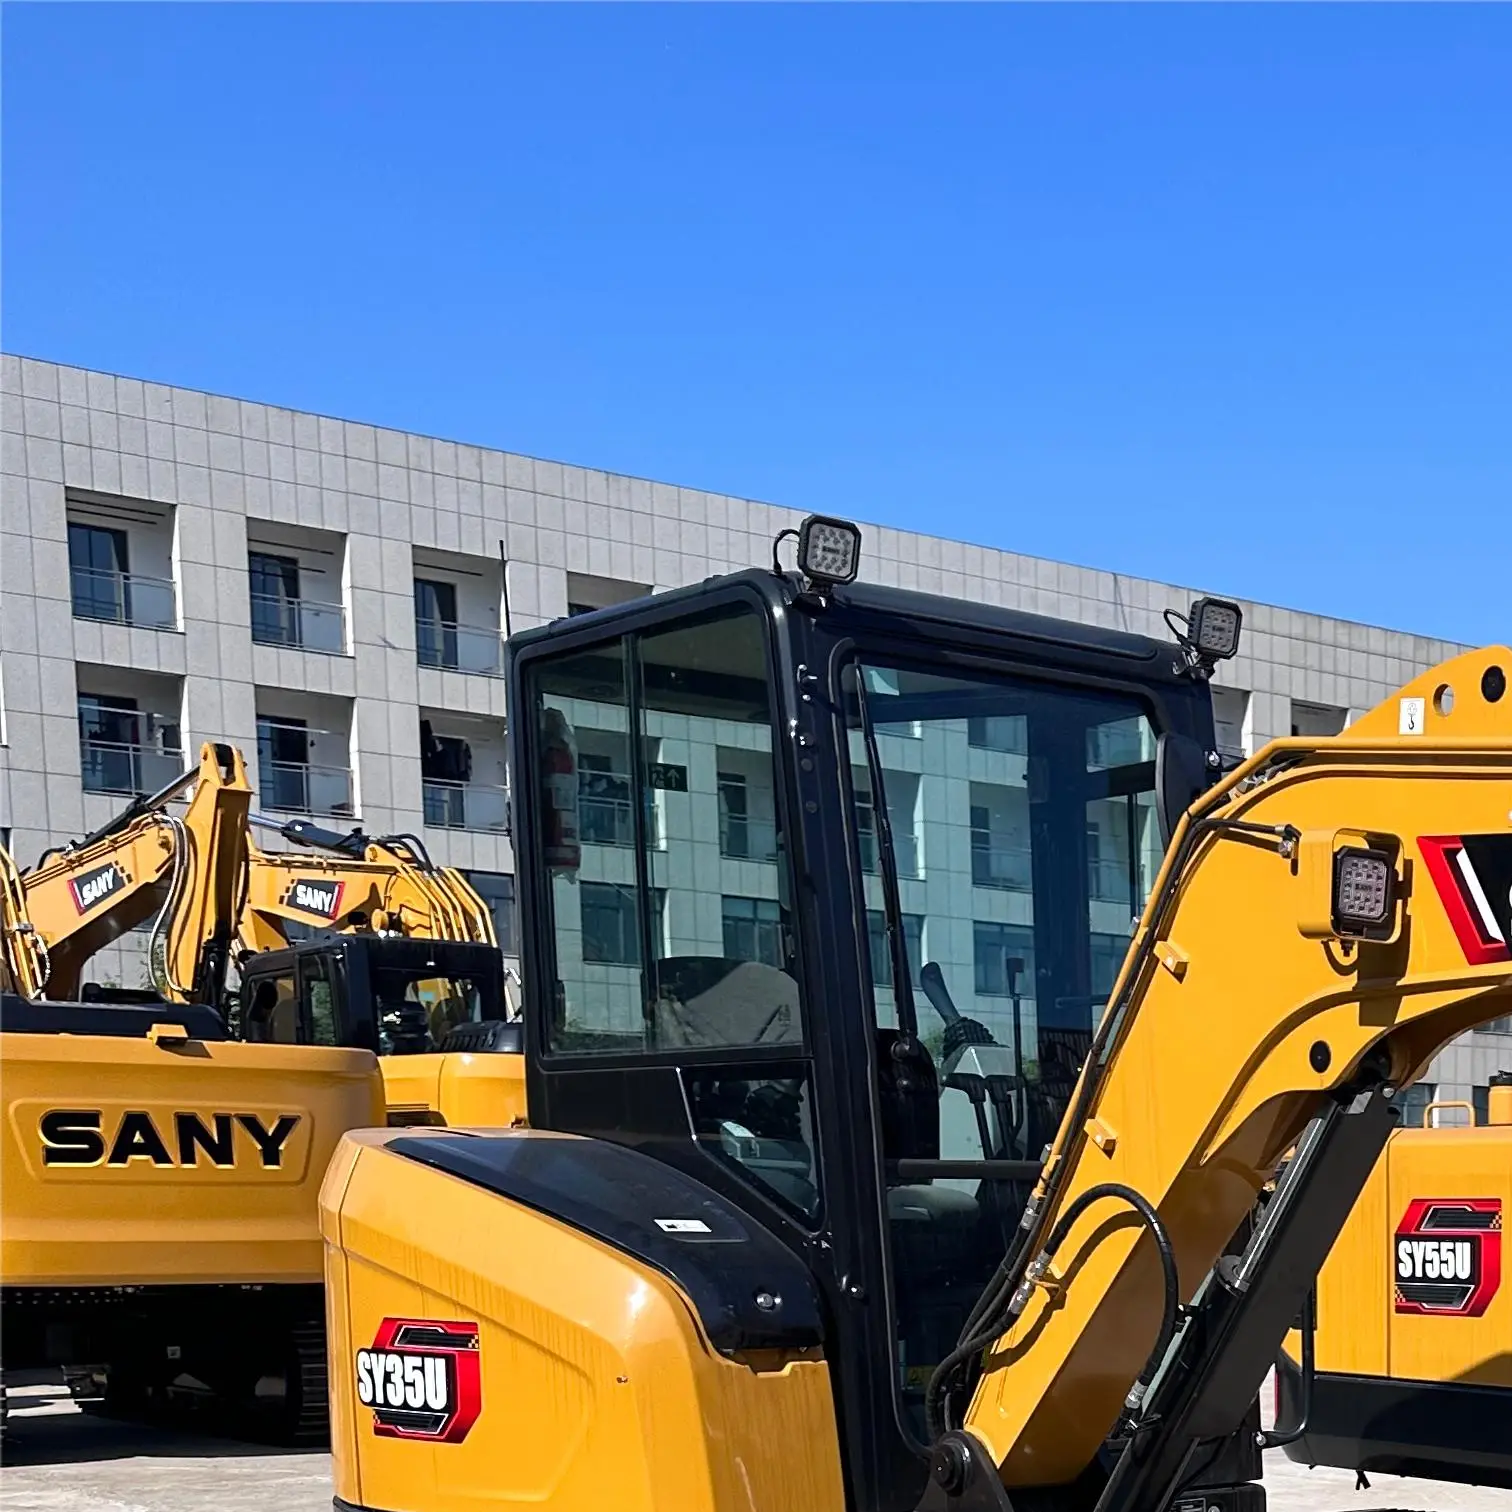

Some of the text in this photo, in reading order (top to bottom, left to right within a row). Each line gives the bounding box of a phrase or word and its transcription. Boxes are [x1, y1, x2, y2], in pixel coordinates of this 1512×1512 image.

[81, 867, 115, 906] SANY
[295, 884, 334, 913] SANY
[38, 1108, 302, 1169] SANY
[1397, 1240, 1472, 1280] SY55U
[356, 1350, 448, 1411] SY35U
